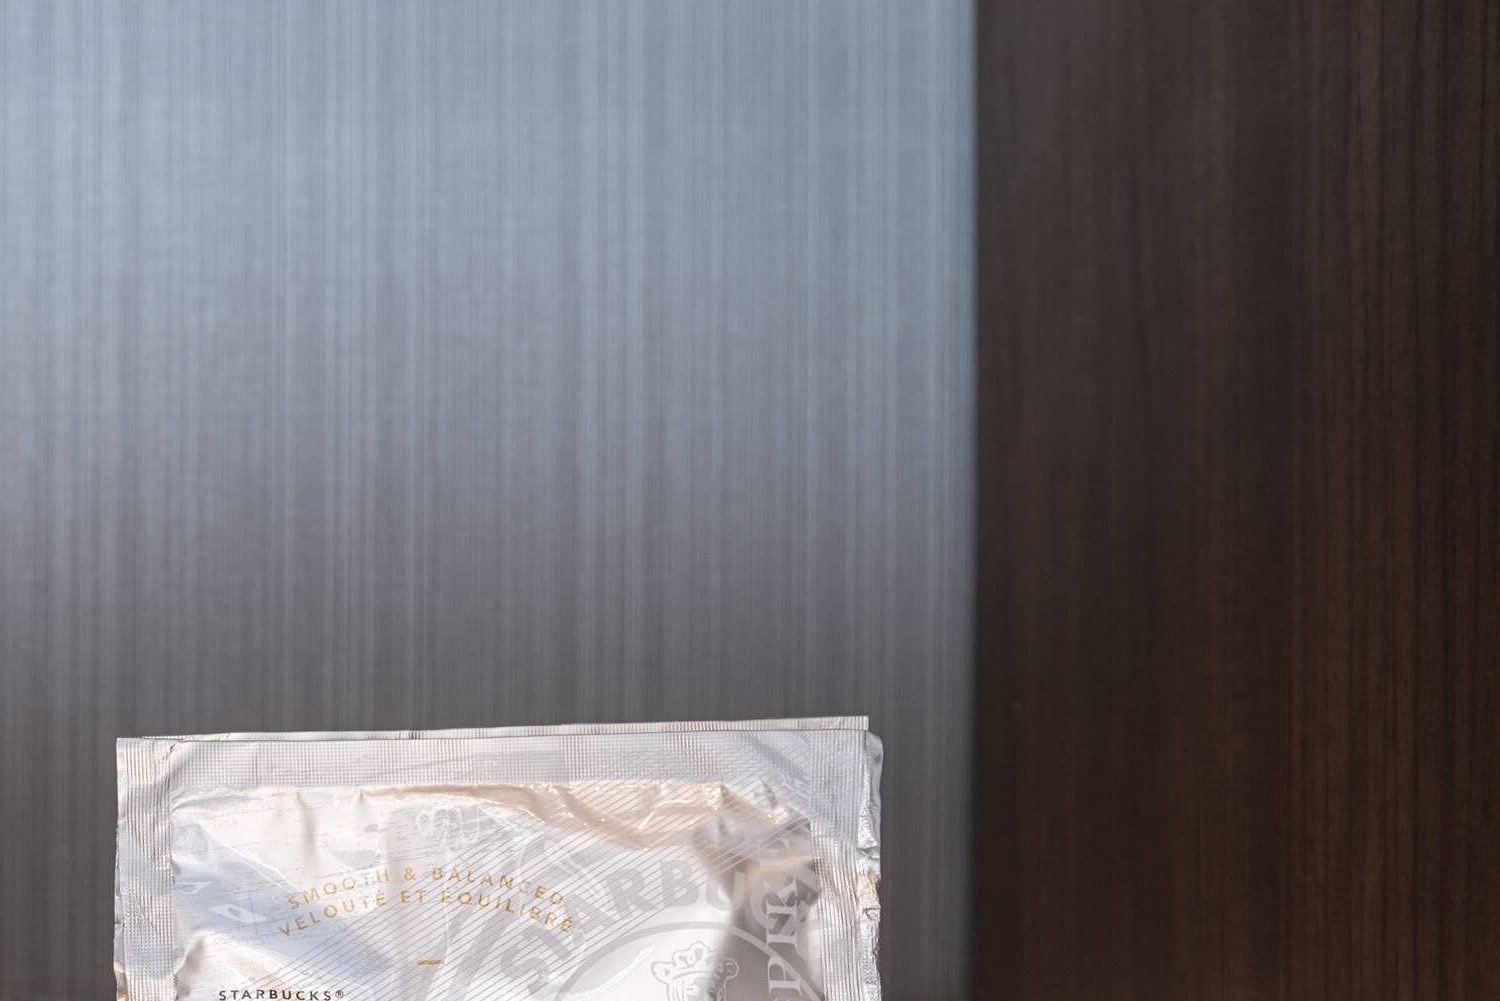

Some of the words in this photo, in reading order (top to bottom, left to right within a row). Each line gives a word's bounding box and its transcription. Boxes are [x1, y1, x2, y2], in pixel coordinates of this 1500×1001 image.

[287, 868, 390, 910] SMOOTH
[403, 866, 417, 881] &
[431, 867, 565, 906] BALANCED
[400, 889, 427, 905] ET
